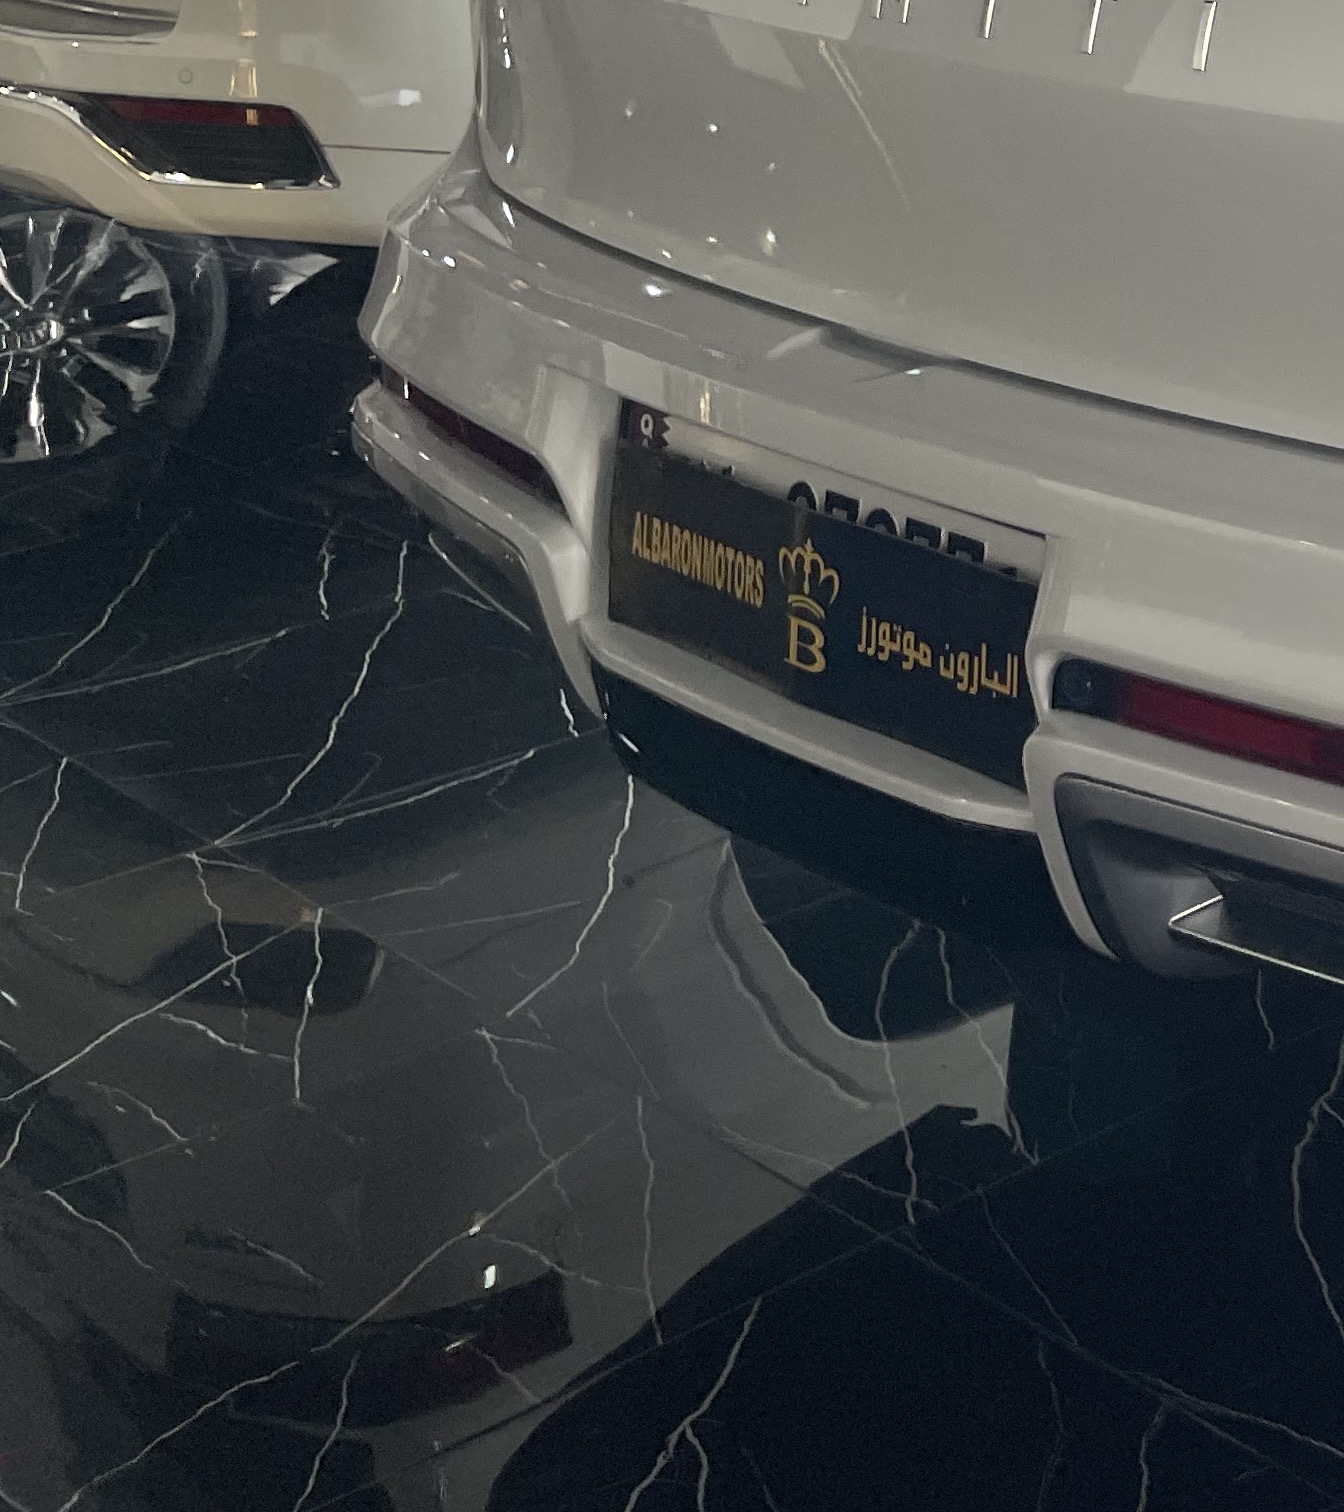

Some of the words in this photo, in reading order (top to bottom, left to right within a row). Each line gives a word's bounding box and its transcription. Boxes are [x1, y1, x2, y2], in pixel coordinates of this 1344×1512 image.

[783, 614, 827, 674] B
[857, 606, 932, 670] موتورز
[938, 642, 1019, 698] البارون
